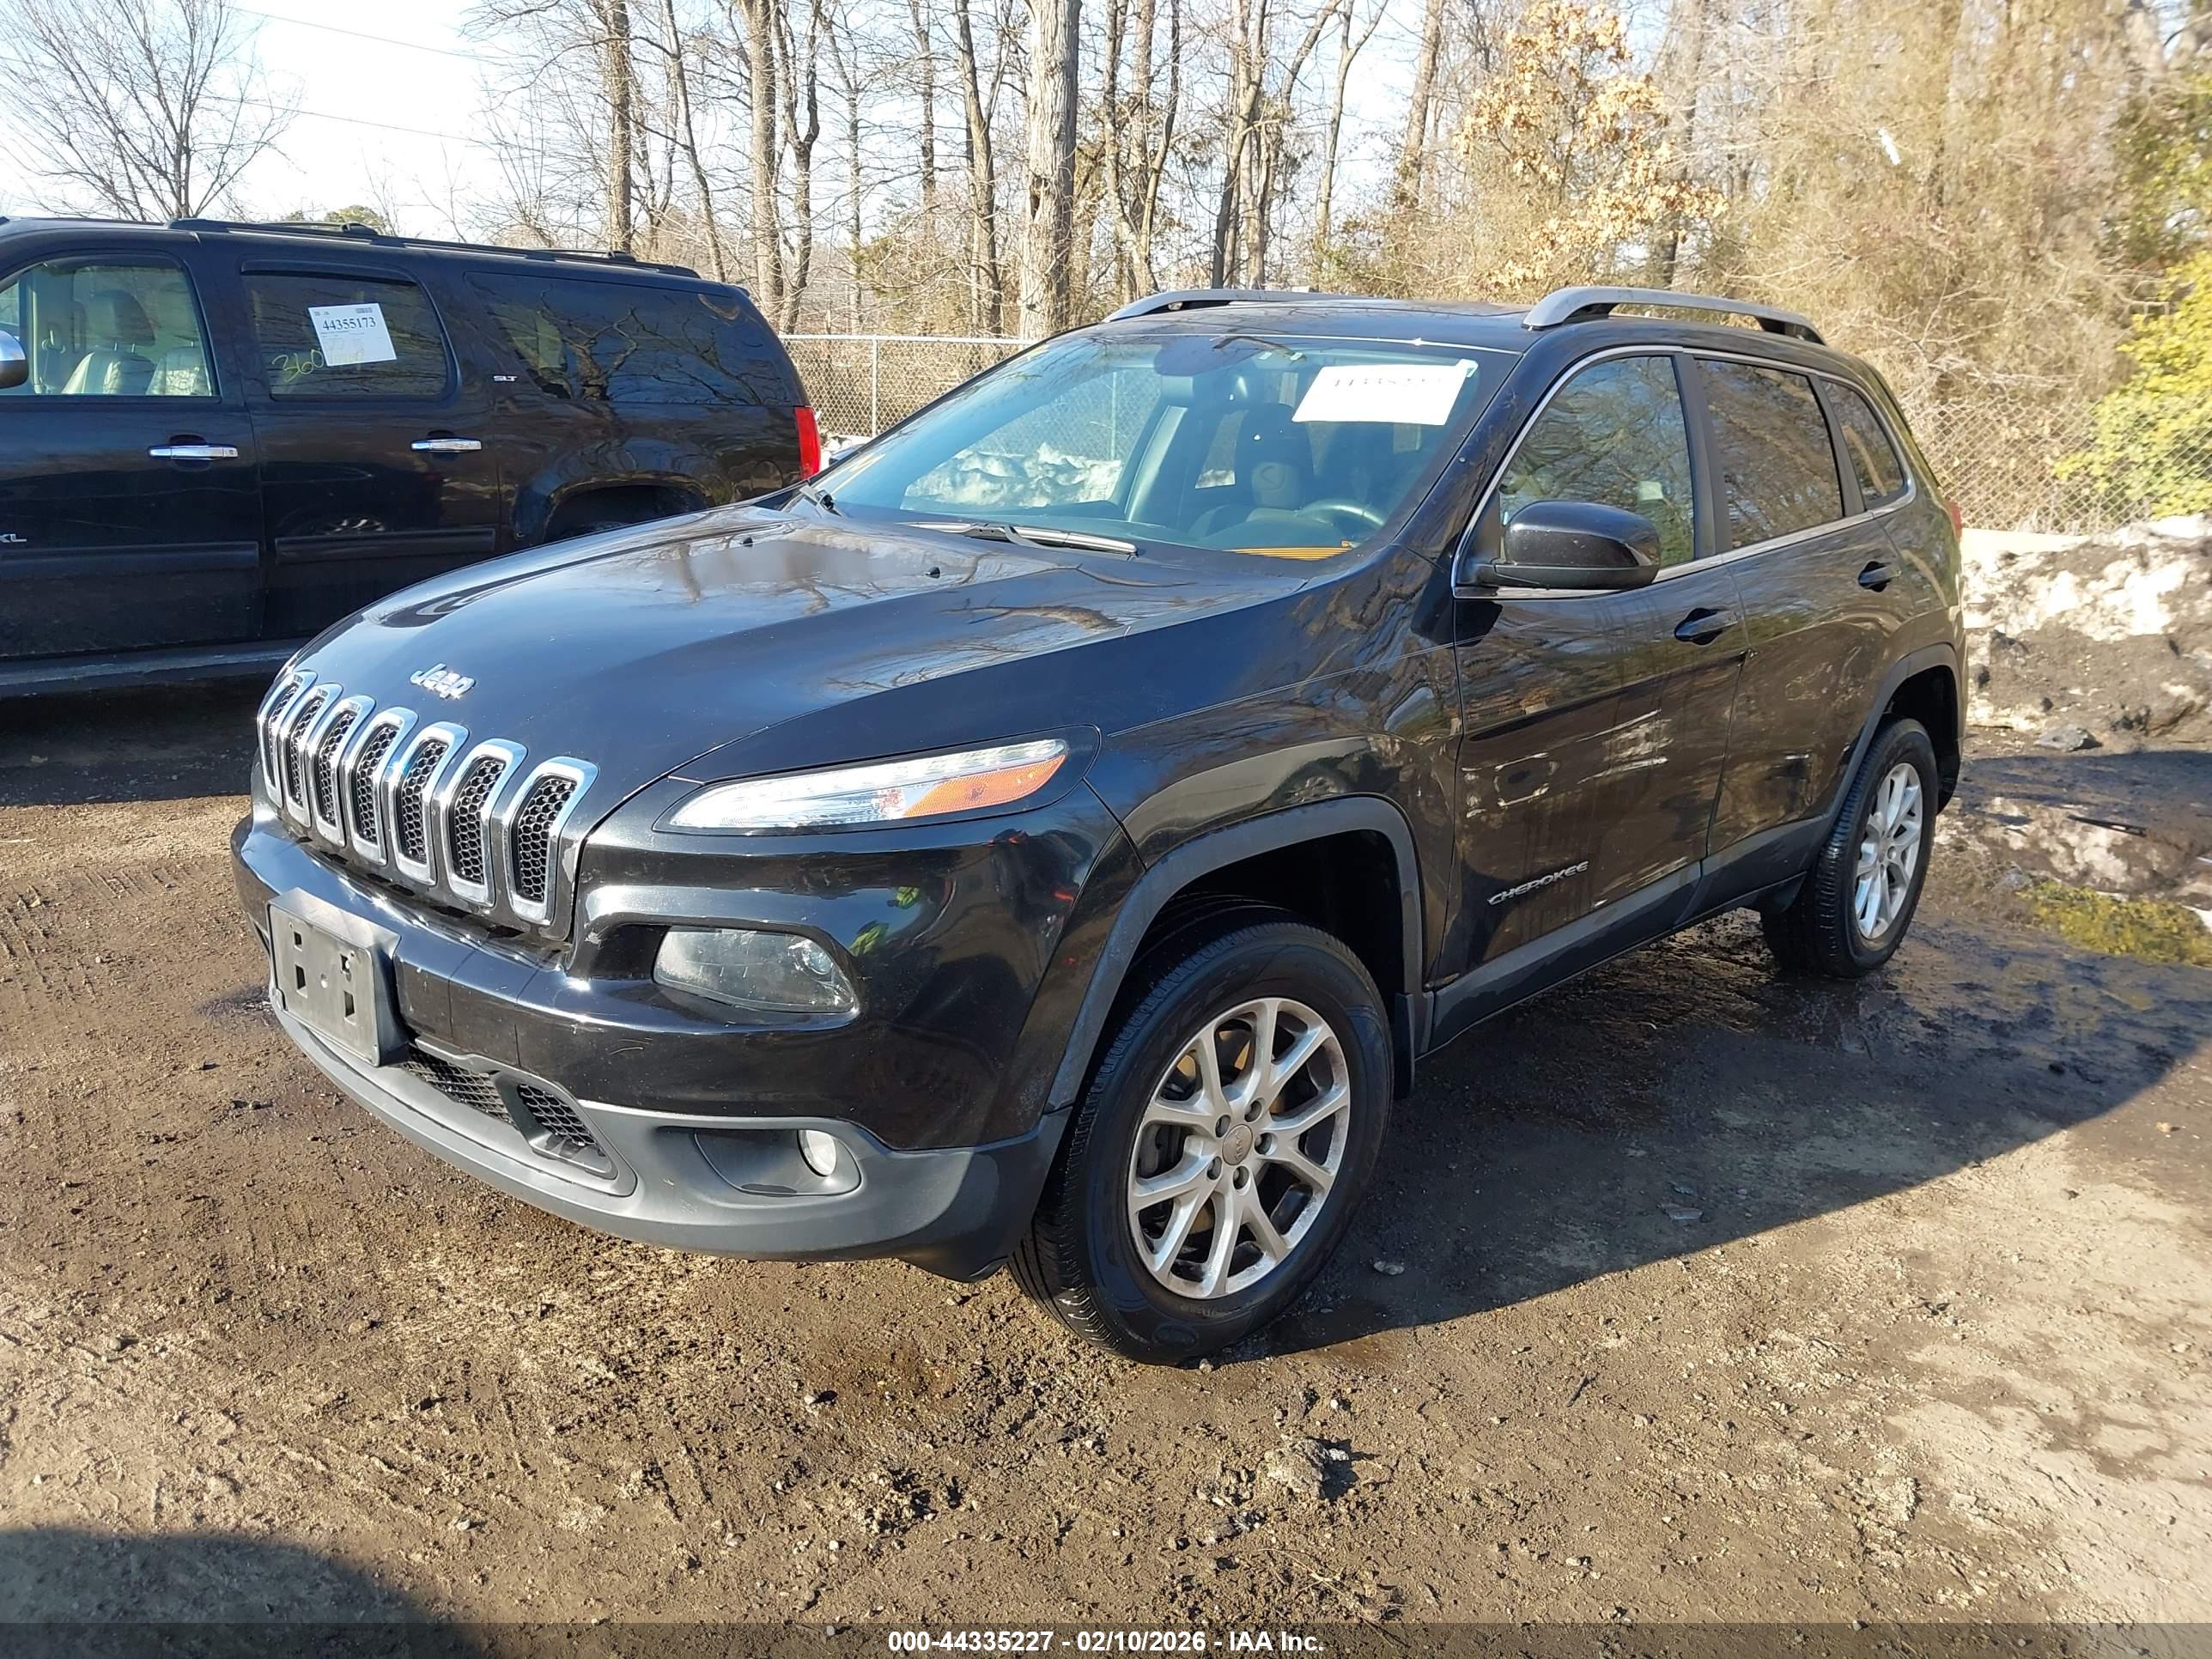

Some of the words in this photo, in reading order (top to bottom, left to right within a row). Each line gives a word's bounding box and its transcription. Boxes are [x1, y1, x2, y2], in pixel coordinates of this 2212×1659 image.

[322, 316, 376, 331] 44355173
[410, 663, 475, 701] Jeep
[1486, 860, 1589, 906] CHEROKEE
